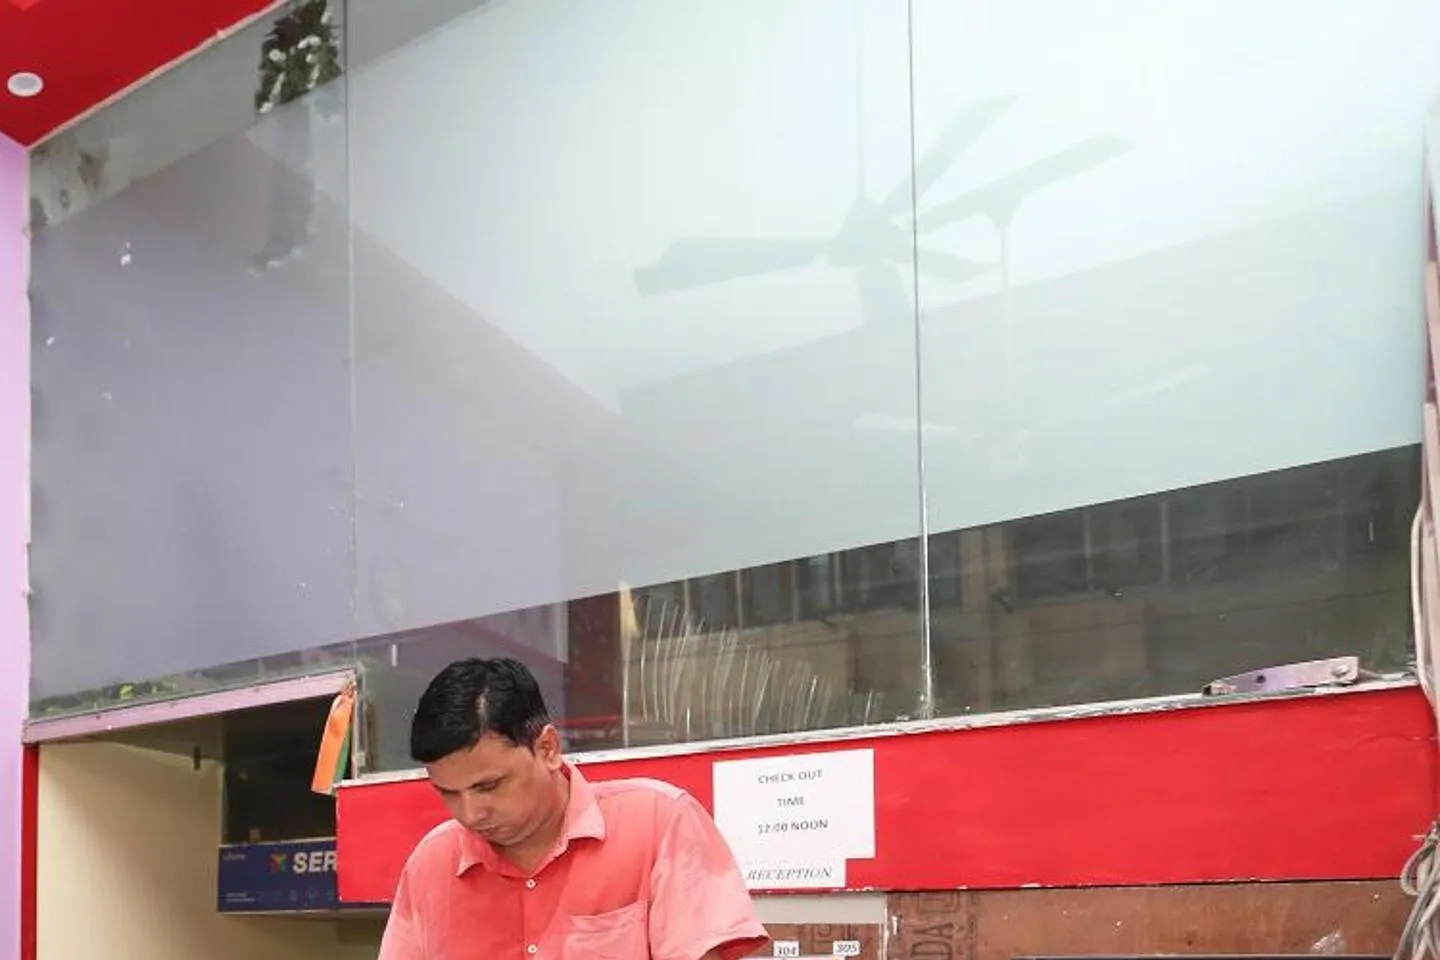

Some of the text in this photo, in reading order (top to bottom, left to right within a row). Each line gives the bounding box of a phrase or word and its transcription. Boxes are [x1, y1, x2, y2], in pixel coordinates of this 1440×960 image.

[758, 769, 823, 784] CHECK OUT
[777, 796, 805, 807] TIME
[791, 819, 829, 831] NOON
[748, 866, 833, 880] RECEPTION
